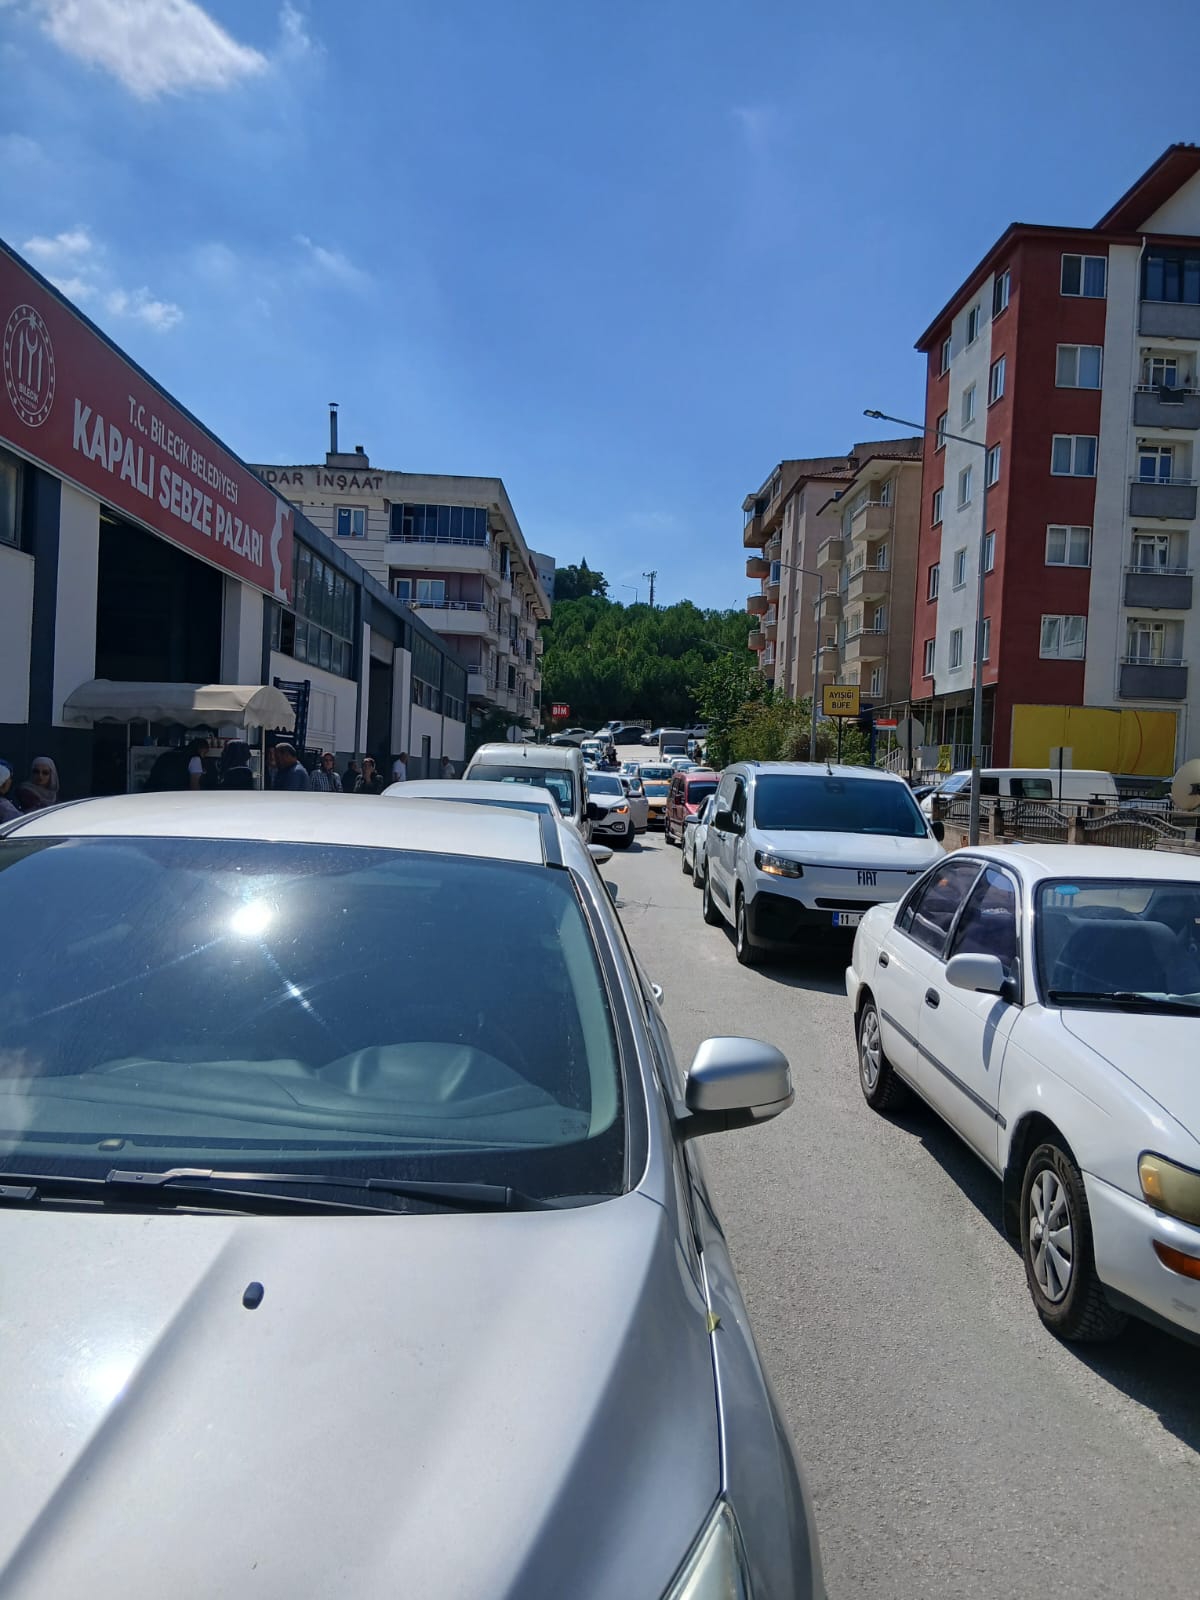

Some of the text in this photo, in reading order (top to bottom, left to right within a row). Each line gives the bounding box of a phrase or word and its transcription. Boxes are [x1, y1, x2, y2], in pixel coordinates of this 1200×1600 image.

[128, 395, 148, 435] T.C.
[72, 397, 264, 567] KAPALI SEBZE PAZARI
[857, 870, 878, 886] FIAT
